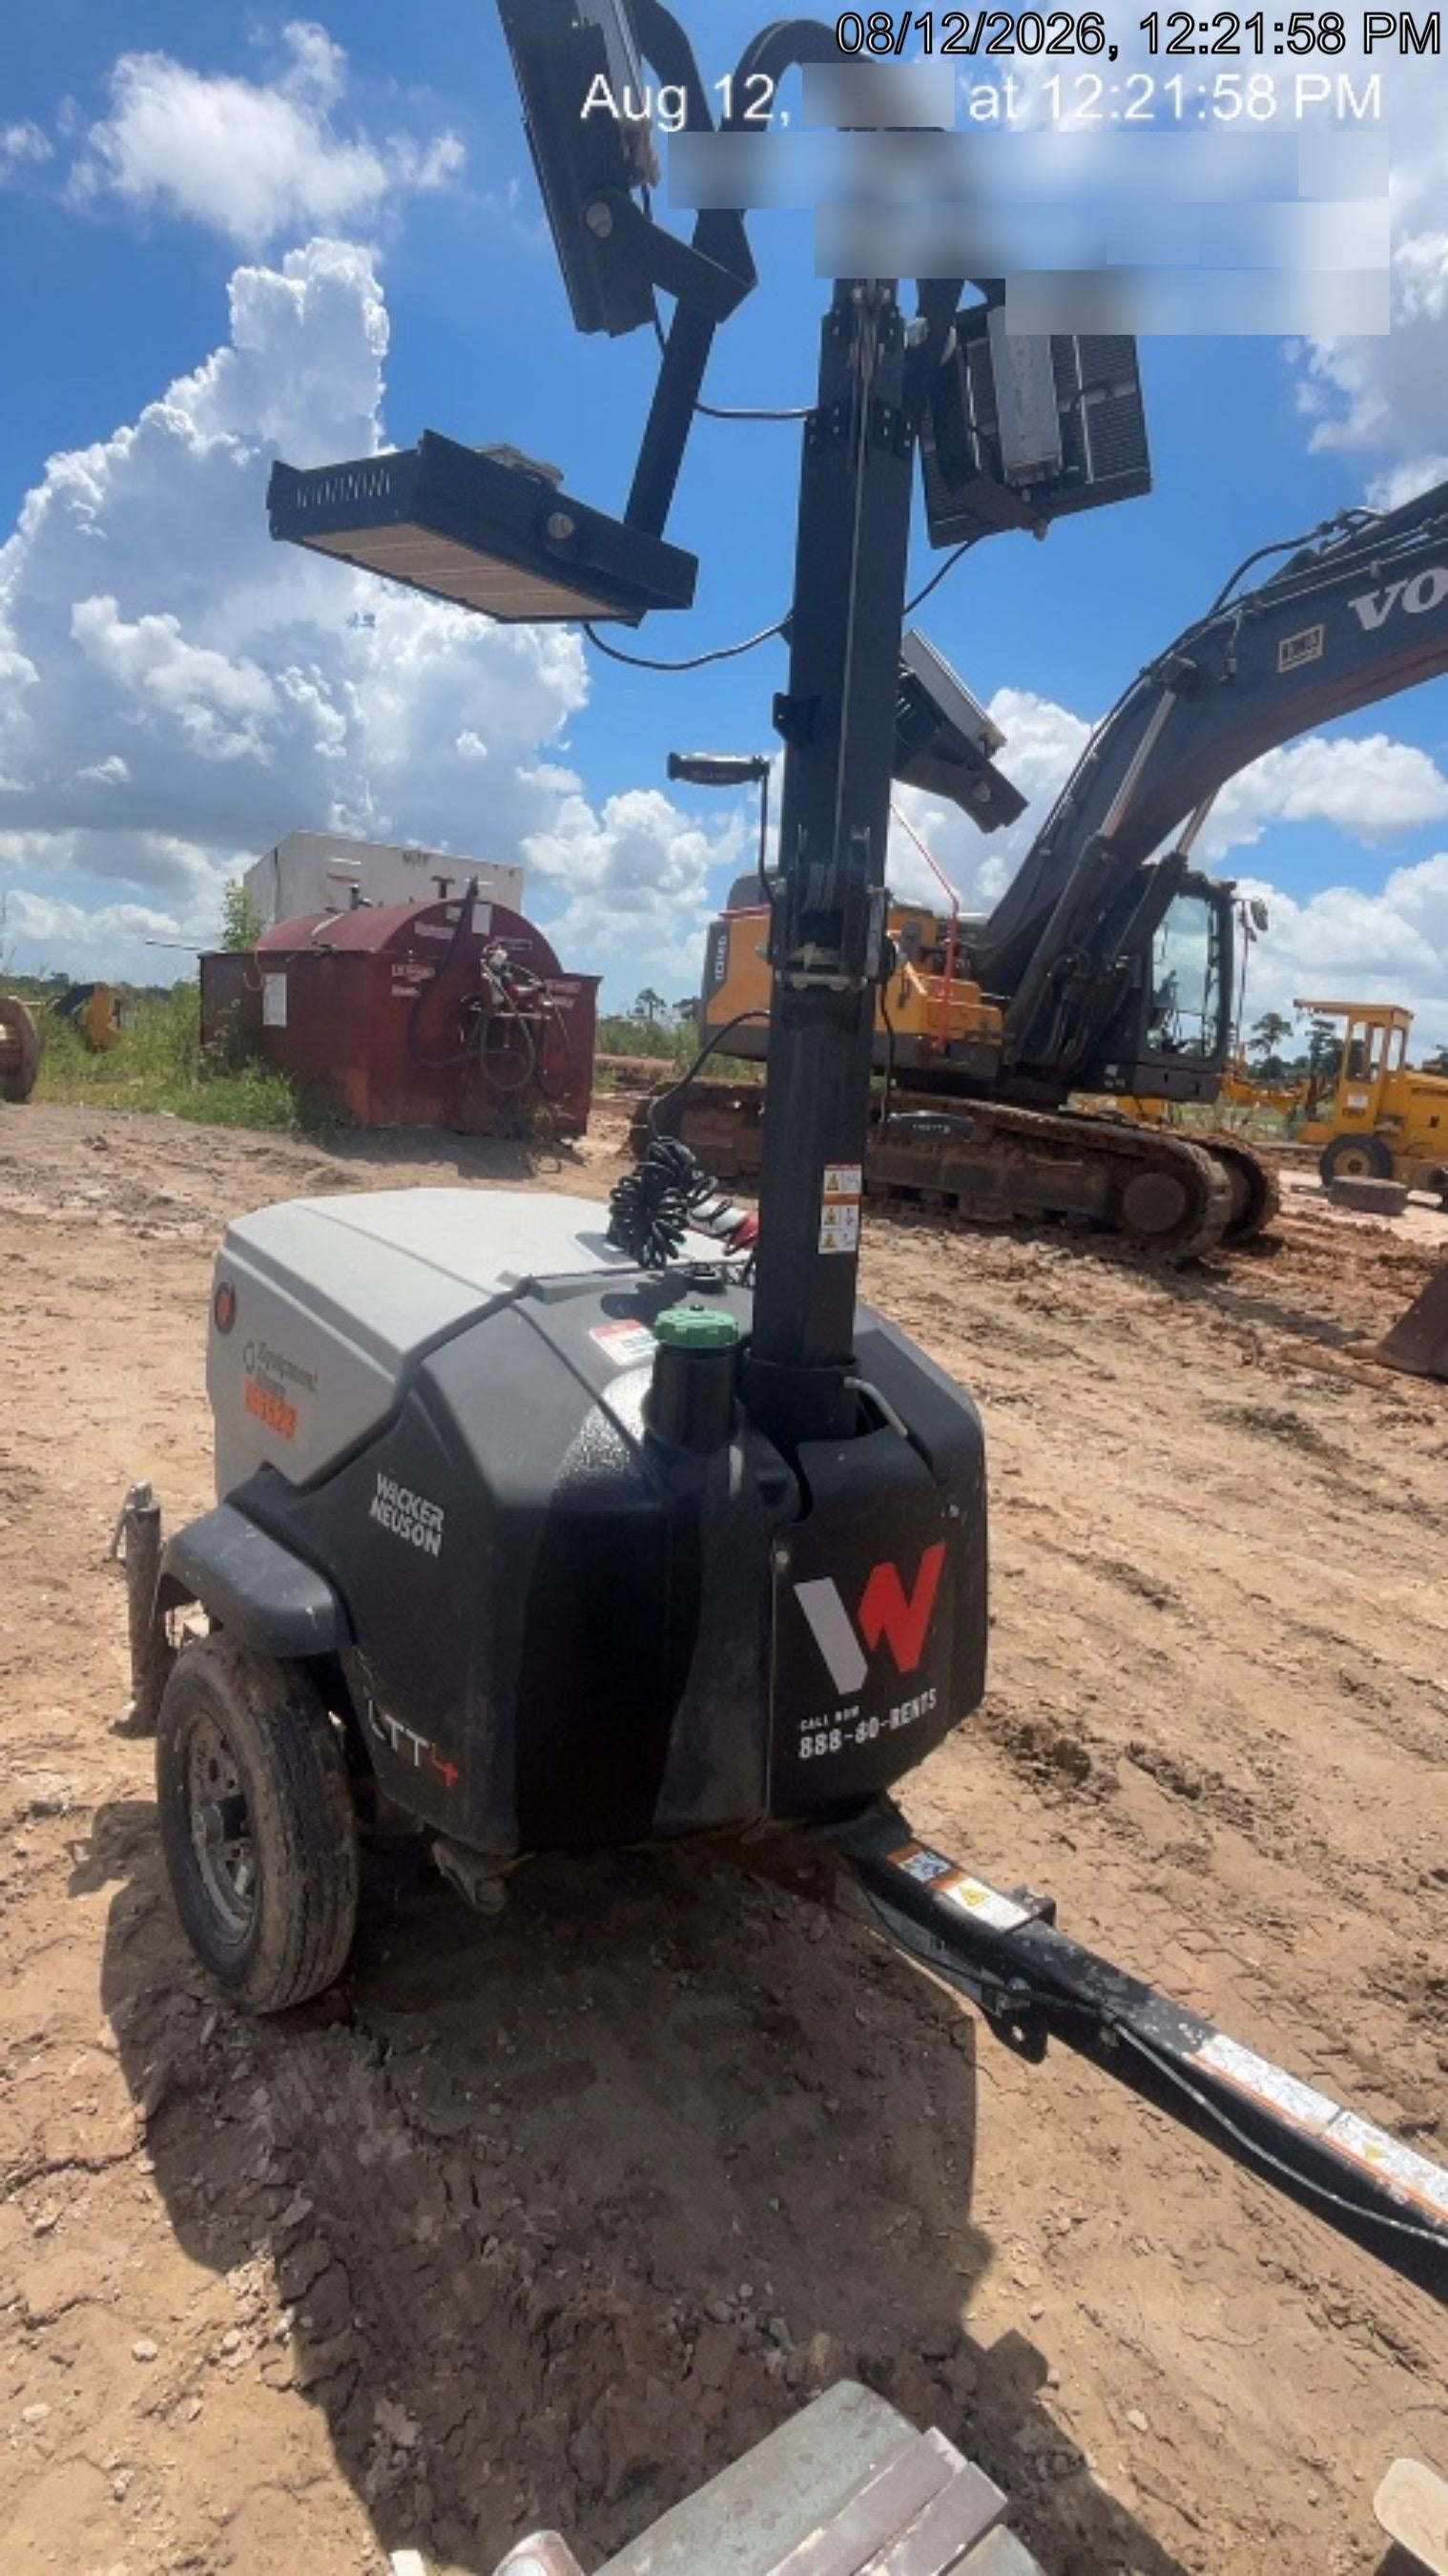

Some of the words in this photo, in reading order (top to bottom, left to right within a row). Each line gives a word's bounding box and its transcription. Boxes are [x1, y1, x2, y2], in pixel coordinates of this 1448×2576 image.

[368, 1495, 443, 1558] NEUSON
[376, 1470, 445, 1532] WACKER
[799, 1714, 829, 1732] CALL
[799, 1687, 938, 1759] 888-80-RENTS
